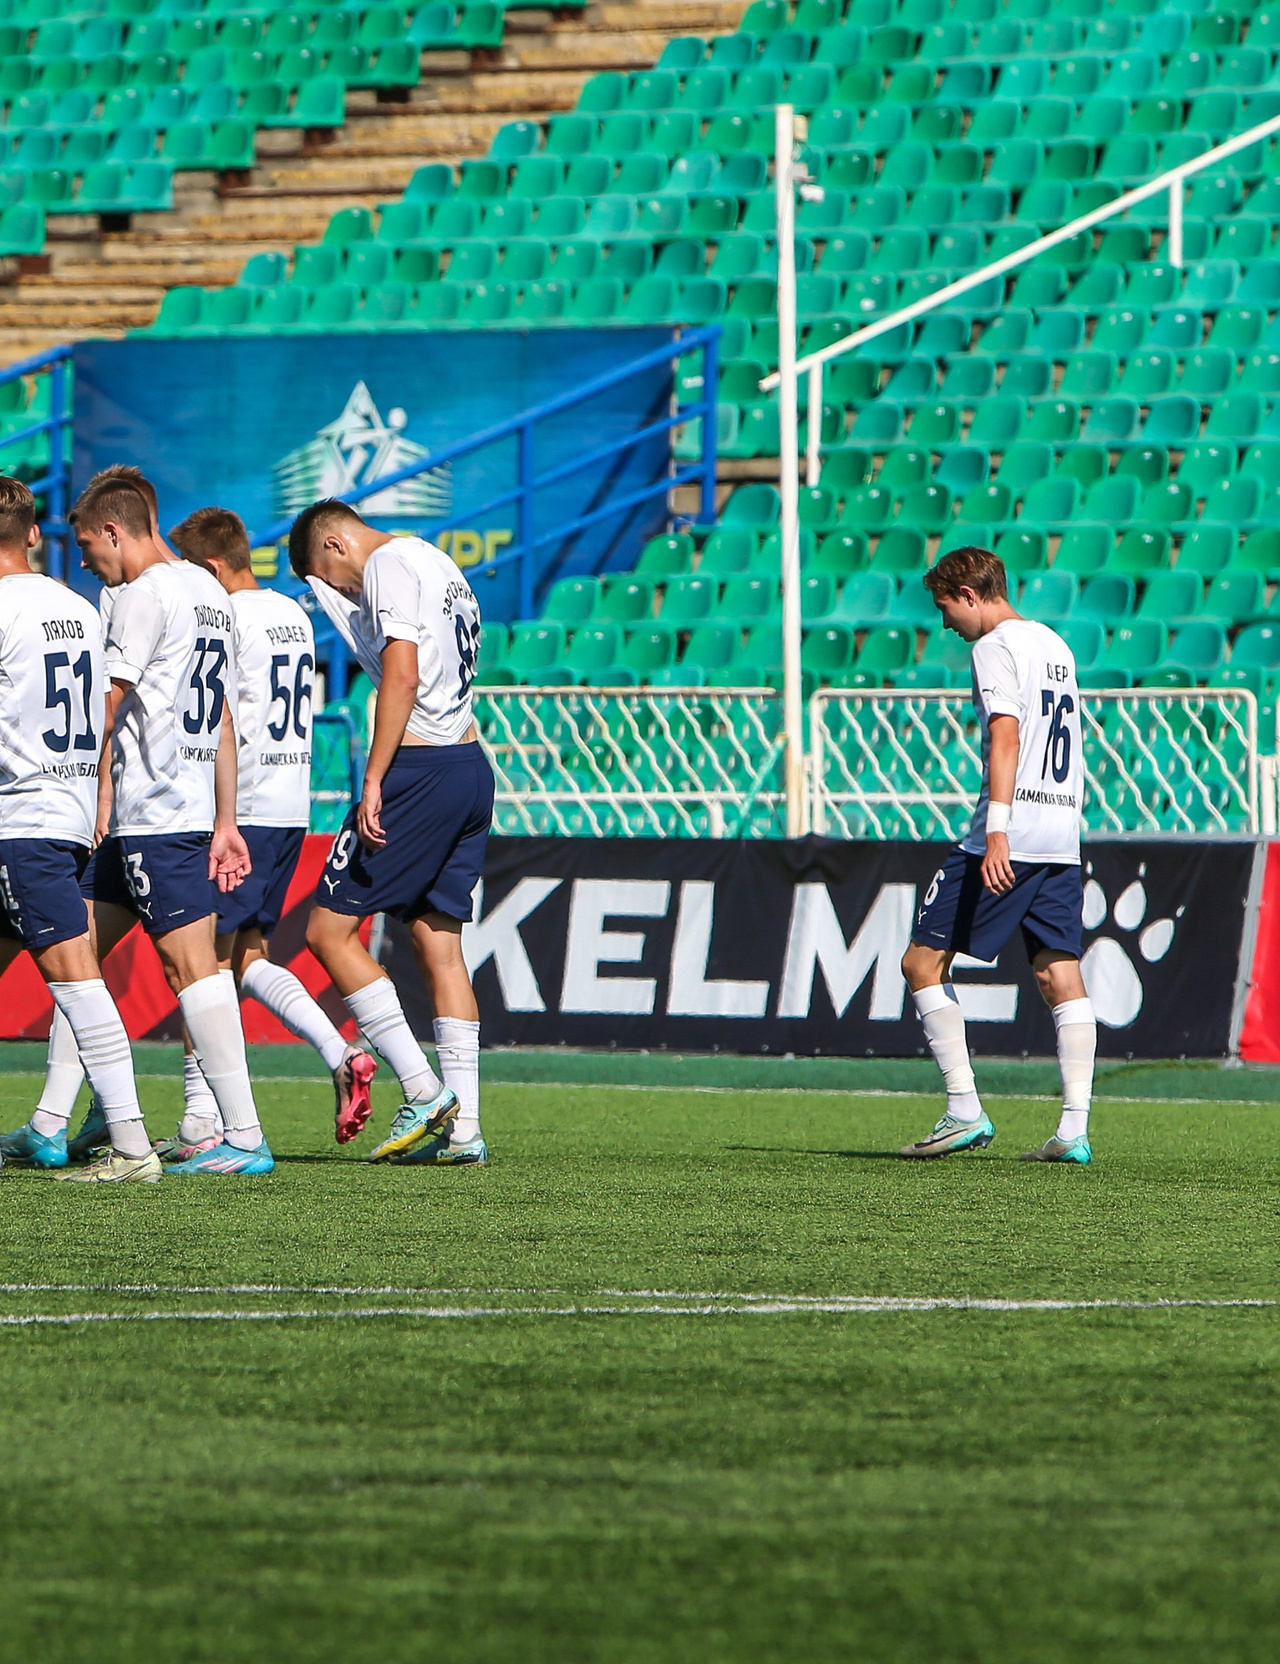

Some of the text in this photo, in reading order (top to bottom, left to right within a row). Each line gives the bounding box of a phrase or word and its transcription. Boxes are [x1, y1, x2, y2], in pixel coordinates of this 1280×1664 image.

[41, 619, 85, 642] ЛЯХОВ
[265, 625, 308, 646] РАДАЕВ
[42, 650, 97, 753] 51
[183, 637, 228, 735] 33
[267, 653, 314, 742] 56
[1041, 689, 1074, 783] 76
